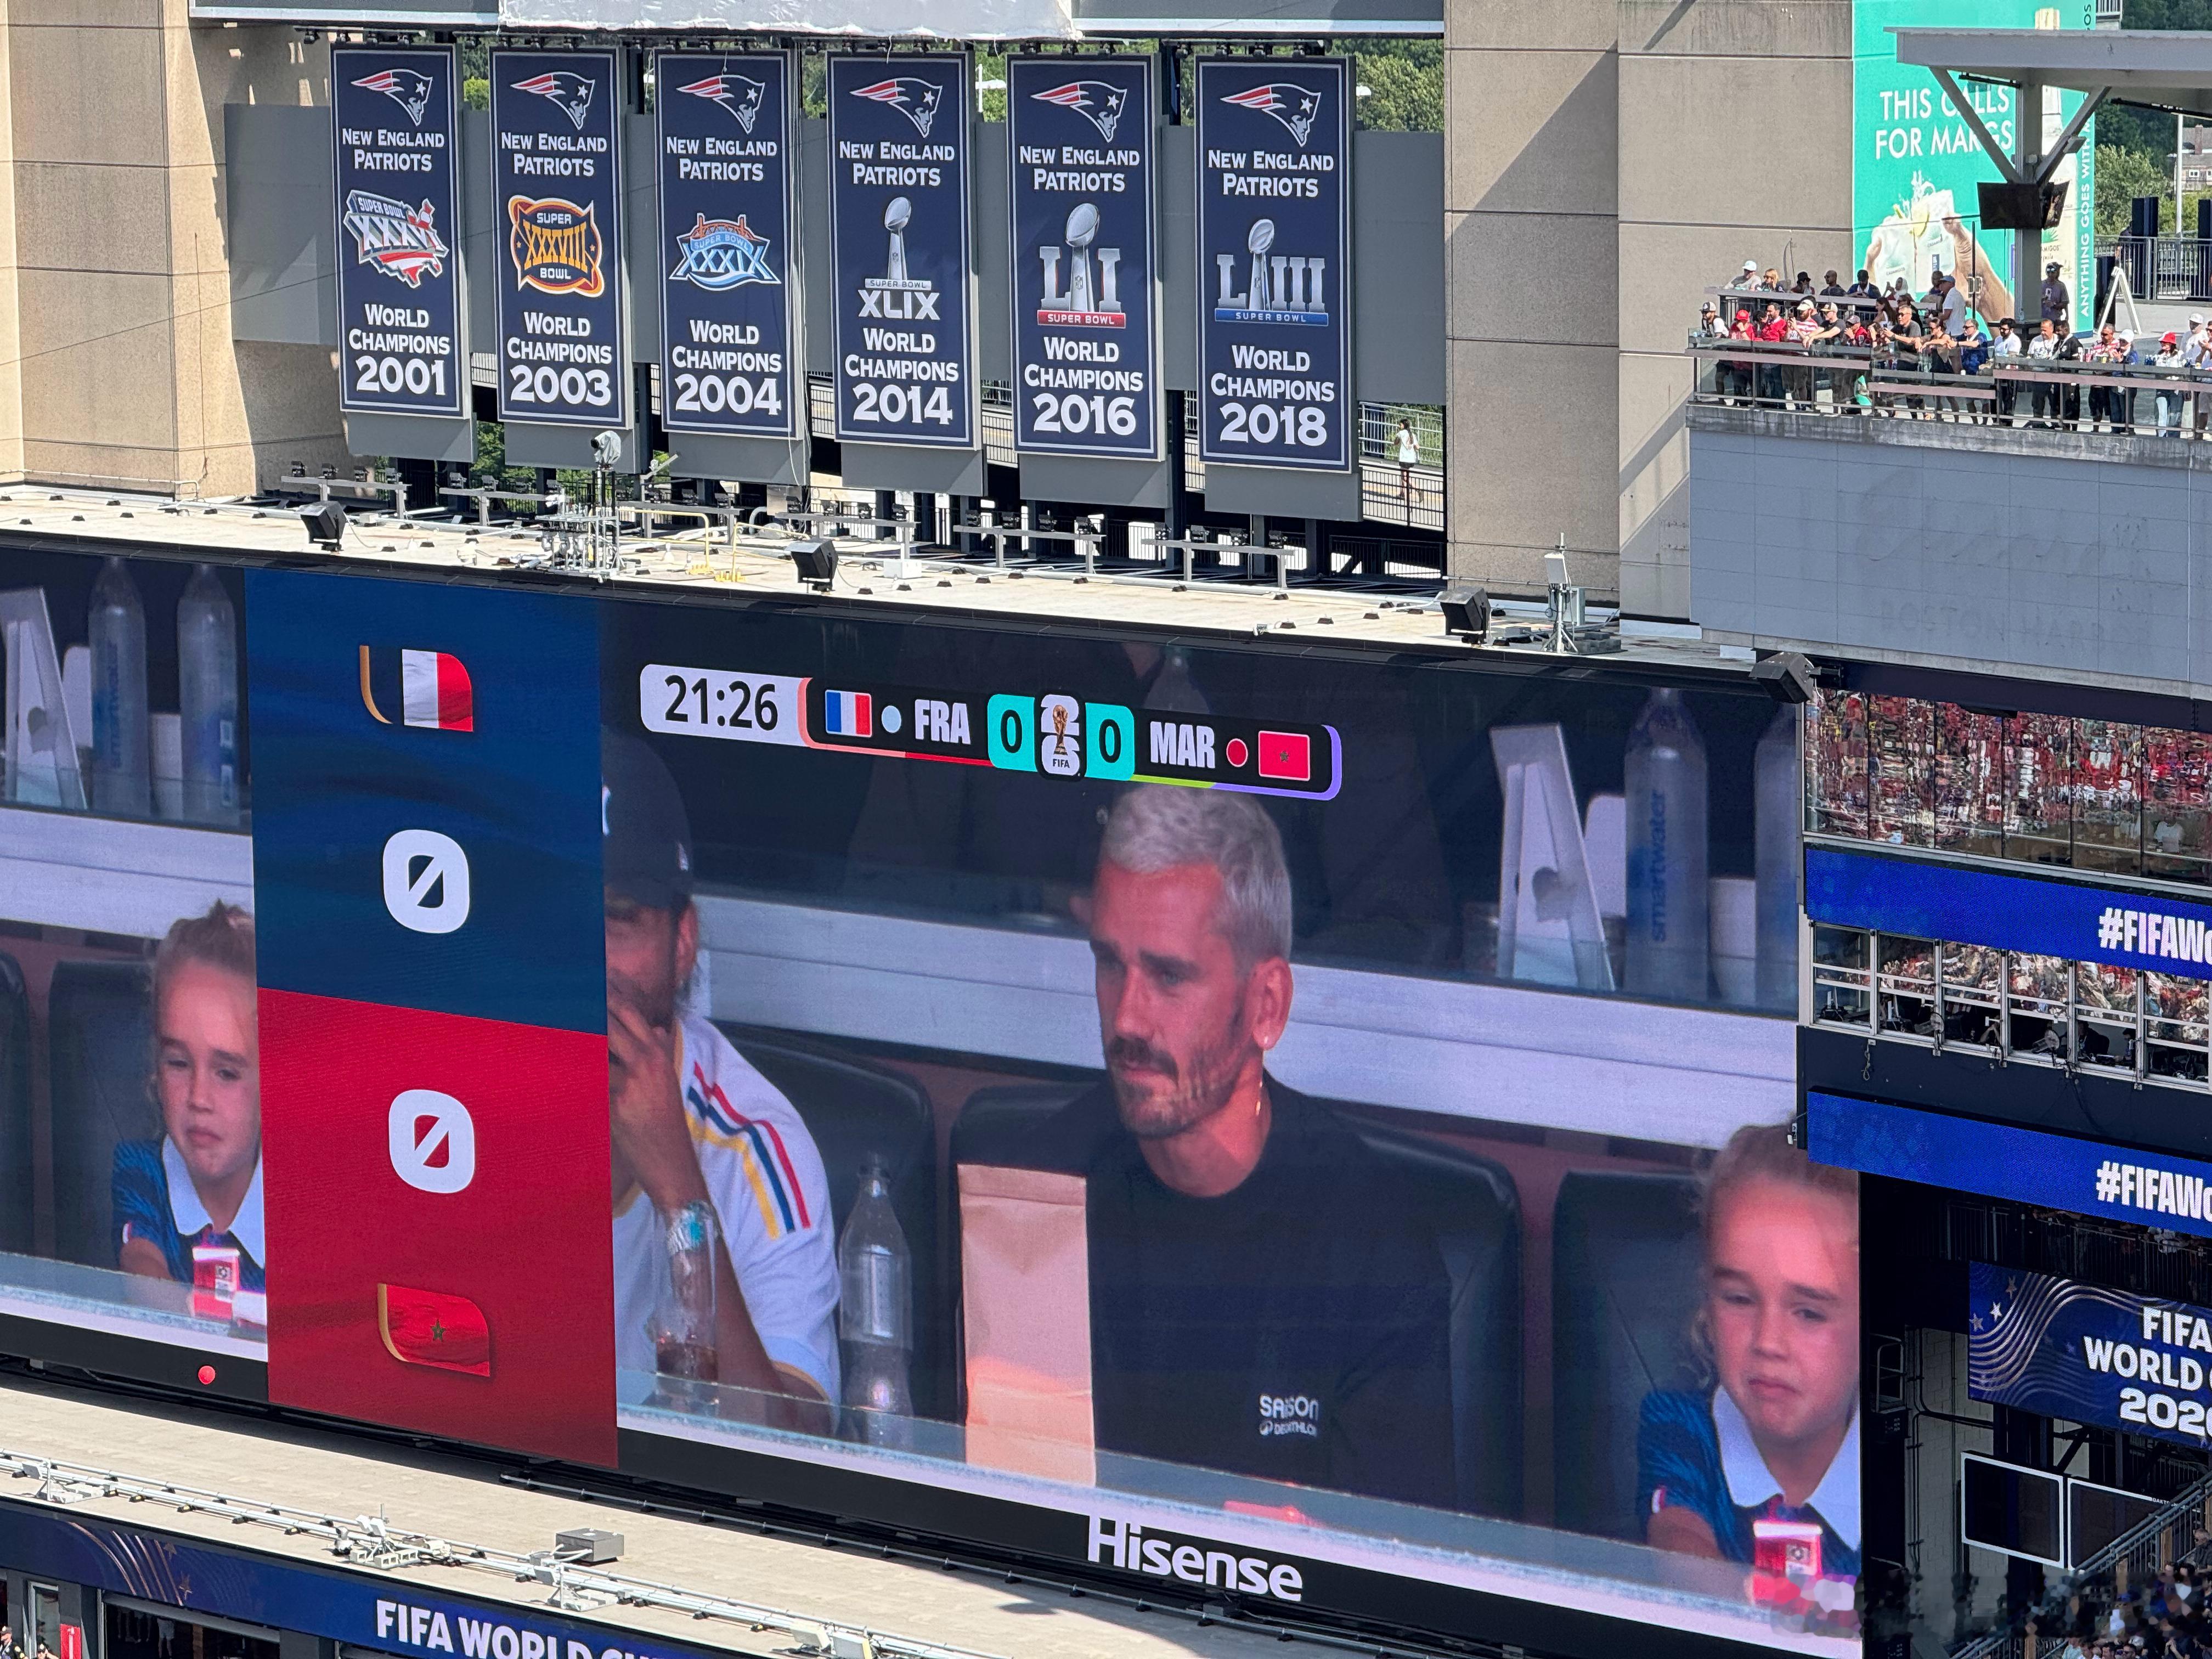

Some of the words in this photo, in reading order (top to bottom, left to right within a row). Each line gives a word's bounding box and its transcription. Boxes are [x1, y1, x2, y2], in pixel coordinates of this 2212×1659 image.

[1880, 88, 1932, 121] THIS
[342, 128, 373, 145] NEW
[377, 129, 445, 148] ENGLAND
[501, 132, 533, 150] NEW
[538, 133, 607, 152] ENGLAND
[667, 136, 699, 154] NEW
[706, 137, 777, 156] ENGLAND
[839, 141, 874, 159] NEW
[880, 142, 955, 161] ENGLAND
[1875, 127, 1923, 160] FOR
[354, 149, 432, 172] PATRIOTS
[514, 153, 594, 177] PATRIOTS
[1020, 145, 1056, 164] NEW
[1062, 146, 1140, 166] ENGLAND
[1208, 150, 1246, 168] NEW
[1253, 150, 1334, 171] ENGLAND
[2081, 138, 2090, 179] WITH
[679, 158, 764, 182] PATRIOTS
[853, 163, 941, 187] PATRIOTS
[1034, 168, 1125, 192] PATRIOTS
[1223, 173, 1318, 198] PATRIOTS
[358, 197, 384, 215] SUPER
[383, 203, 406, 218] BOWL
[537, 212, 572, 224] SUPER
[2080, 183, 2090, 228] GOES
[523, 219, 588, 274] XXXVIII
[694, 234, 721, 252] SUPER
[725, 234, 748, 251] BOWL
[540, 267, 572, 280] BOWL
[676, 243, 773, 279] XXXIX
[2080, 233, 2090, 317] ANYTHING
[1217, 254, 1325, 312] LIII
[364, 303, 429, 328] WORLD
[857, 289, 940, 320] XLIX
[1235, 312, 1271, 321] SUPER
[523, 312, 590, 337] WORLD
[690, 319, 759, 345] WORLD
[1047, 313, 1081, 323] SUPER
[1085, 315, 1115, 325] BOWL
[348, 328, 450, 355] CHAMPIONS
[507, 337, 612, 365] CHAMPIONS
[863, 328, 935, 353] WORLD
[1043, 336, 1119, 363] WORLD
[672, 346, 782, 373] CHAMPIONS
[845, 354, 960, 382] CHAMPIONS
[1232, 345, 1310, 372] WORLD
[356, 357, 446, 396] 2001
[510, 365, 611, 406] 2003
[1024, 364, 1143, 392] CHAMPIONS
[1211, 373, 1335, 402] CHAMPIONS
[674, 374, 782, 416] 2004
[852, 382, 953, 425] 2014
[1032, 393, 1137, 436] 2016
[1219, 403, 1328, 447] 2018
[664, 674, 778, 731] 21:26
[915, 699, 971, 745] FRA
[1001, 709, 1022, 753] 0
[1099, 719, 1121, 763] 0
[1150, 721, 1216, 769] MAR
[1052, 758, 1070, 769] FIFA
[382, 829, 470, 934] 0
[388, 1089, 476, 1194] 0
[2142, 1306, 2212, 1353] FIFA
[2084, 1335, 2203, 1391] WORLD
[2120, 1387, 2212, 1437] 202
[1088, 1514, 1302, 1601] Hisense
[376, 1600, 454, 1654] FIFA
